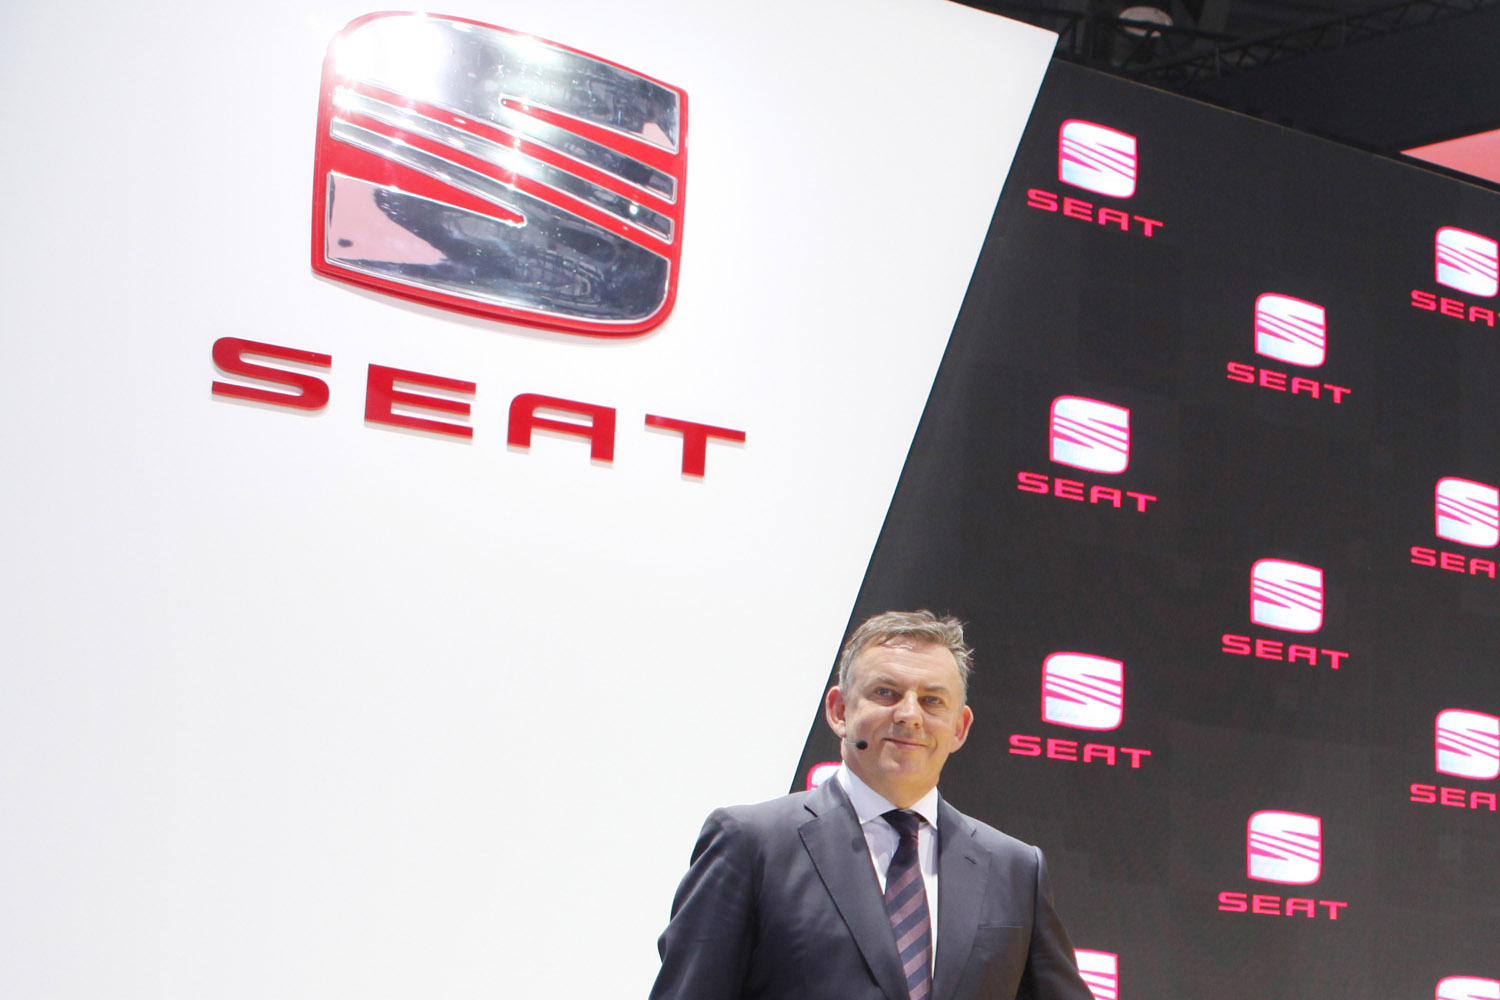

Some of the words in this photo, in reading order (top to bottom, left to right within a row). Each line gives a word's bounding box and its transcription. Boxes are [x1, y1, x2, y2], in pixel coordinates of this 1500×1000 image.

[1026, 188, 1164, 237] SEAT
[1226, 361, 1352, 404] SEAT
[212, 337, 746, 478] SEAT
[1016, 471, 1158, 512] SEAT
[1221, 634, 1350, 670] SEAT
[1008, 734, 1152, 768] SEAT
[1217, 891, 1349, 920] SEAT
